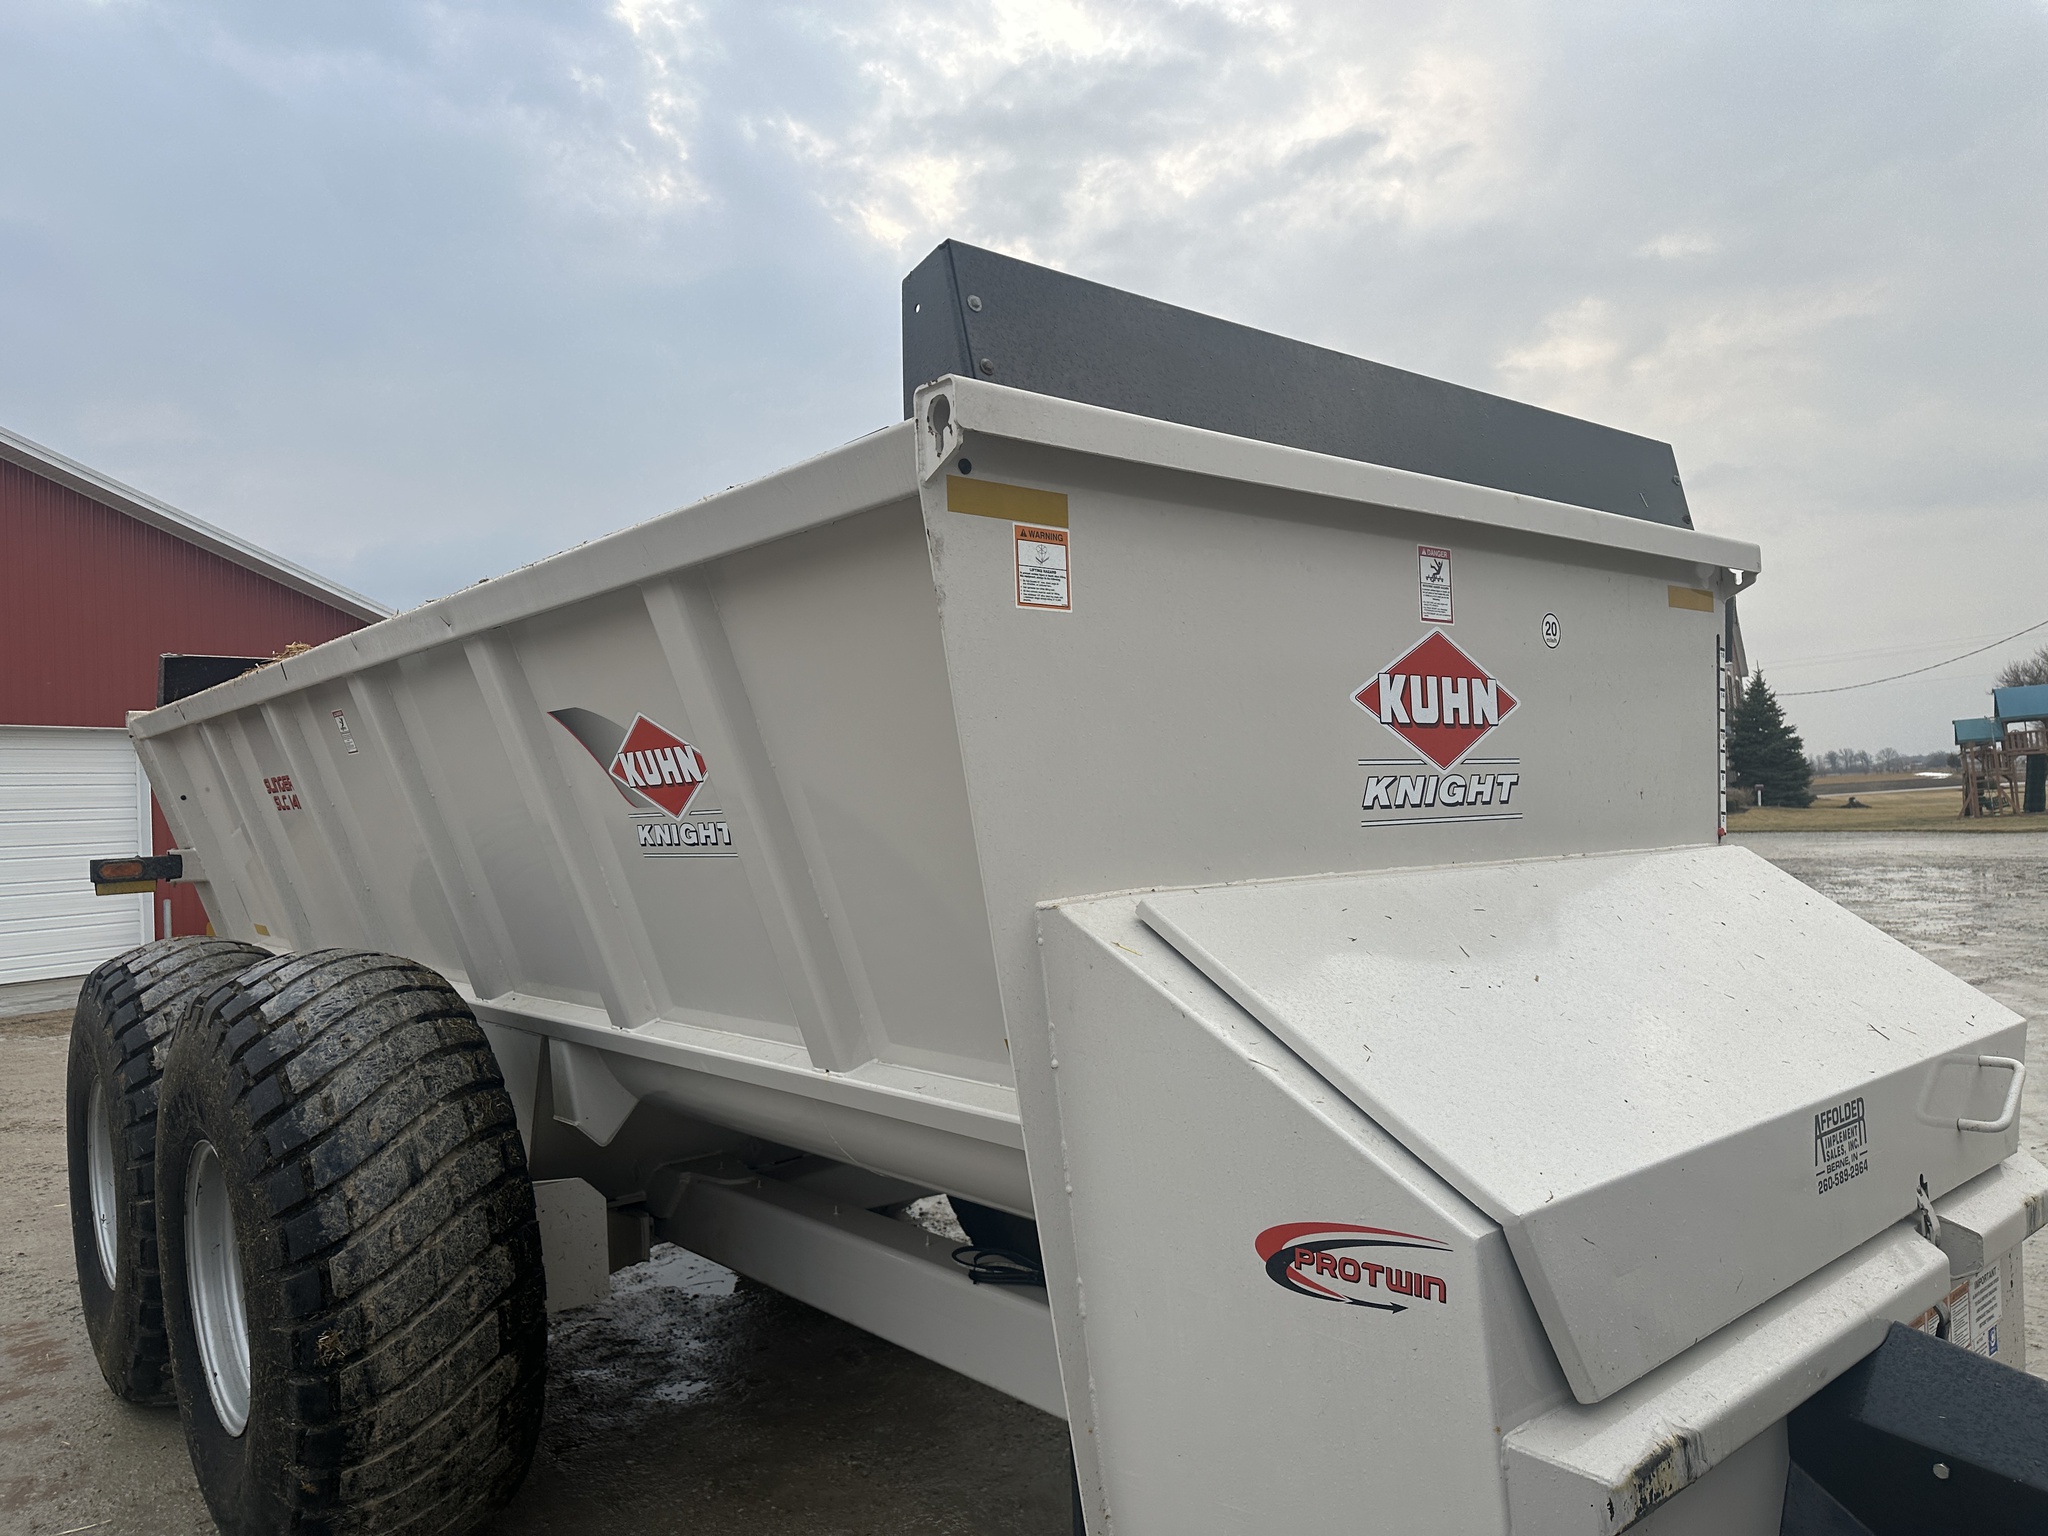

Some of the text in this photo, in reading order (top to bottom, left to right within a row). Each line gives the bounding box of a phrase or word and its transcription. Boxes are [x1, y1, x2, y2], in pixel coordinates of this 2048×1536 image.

[1028, 530, 1064, 542] WARNING
[1426, 548, 1448, 559] DANGER
[1544, 620, 1558, 637] 20
[1378, 673, 1499, 728] KUHN
[617, 744, 704, 788] KUHN
[1362, 773, 1520, 810] KNIGHT
[637, 821, 732, 847] KNIGHT
[1825, 1125, 1858, 1149] IMPLEMENT
[1826, 1144, 1847, 1162] SALES,
[1826, 1152, 1859, 1174] BERNE, IN
[1818, 1159, 1868, 1195] 260-589-2964
